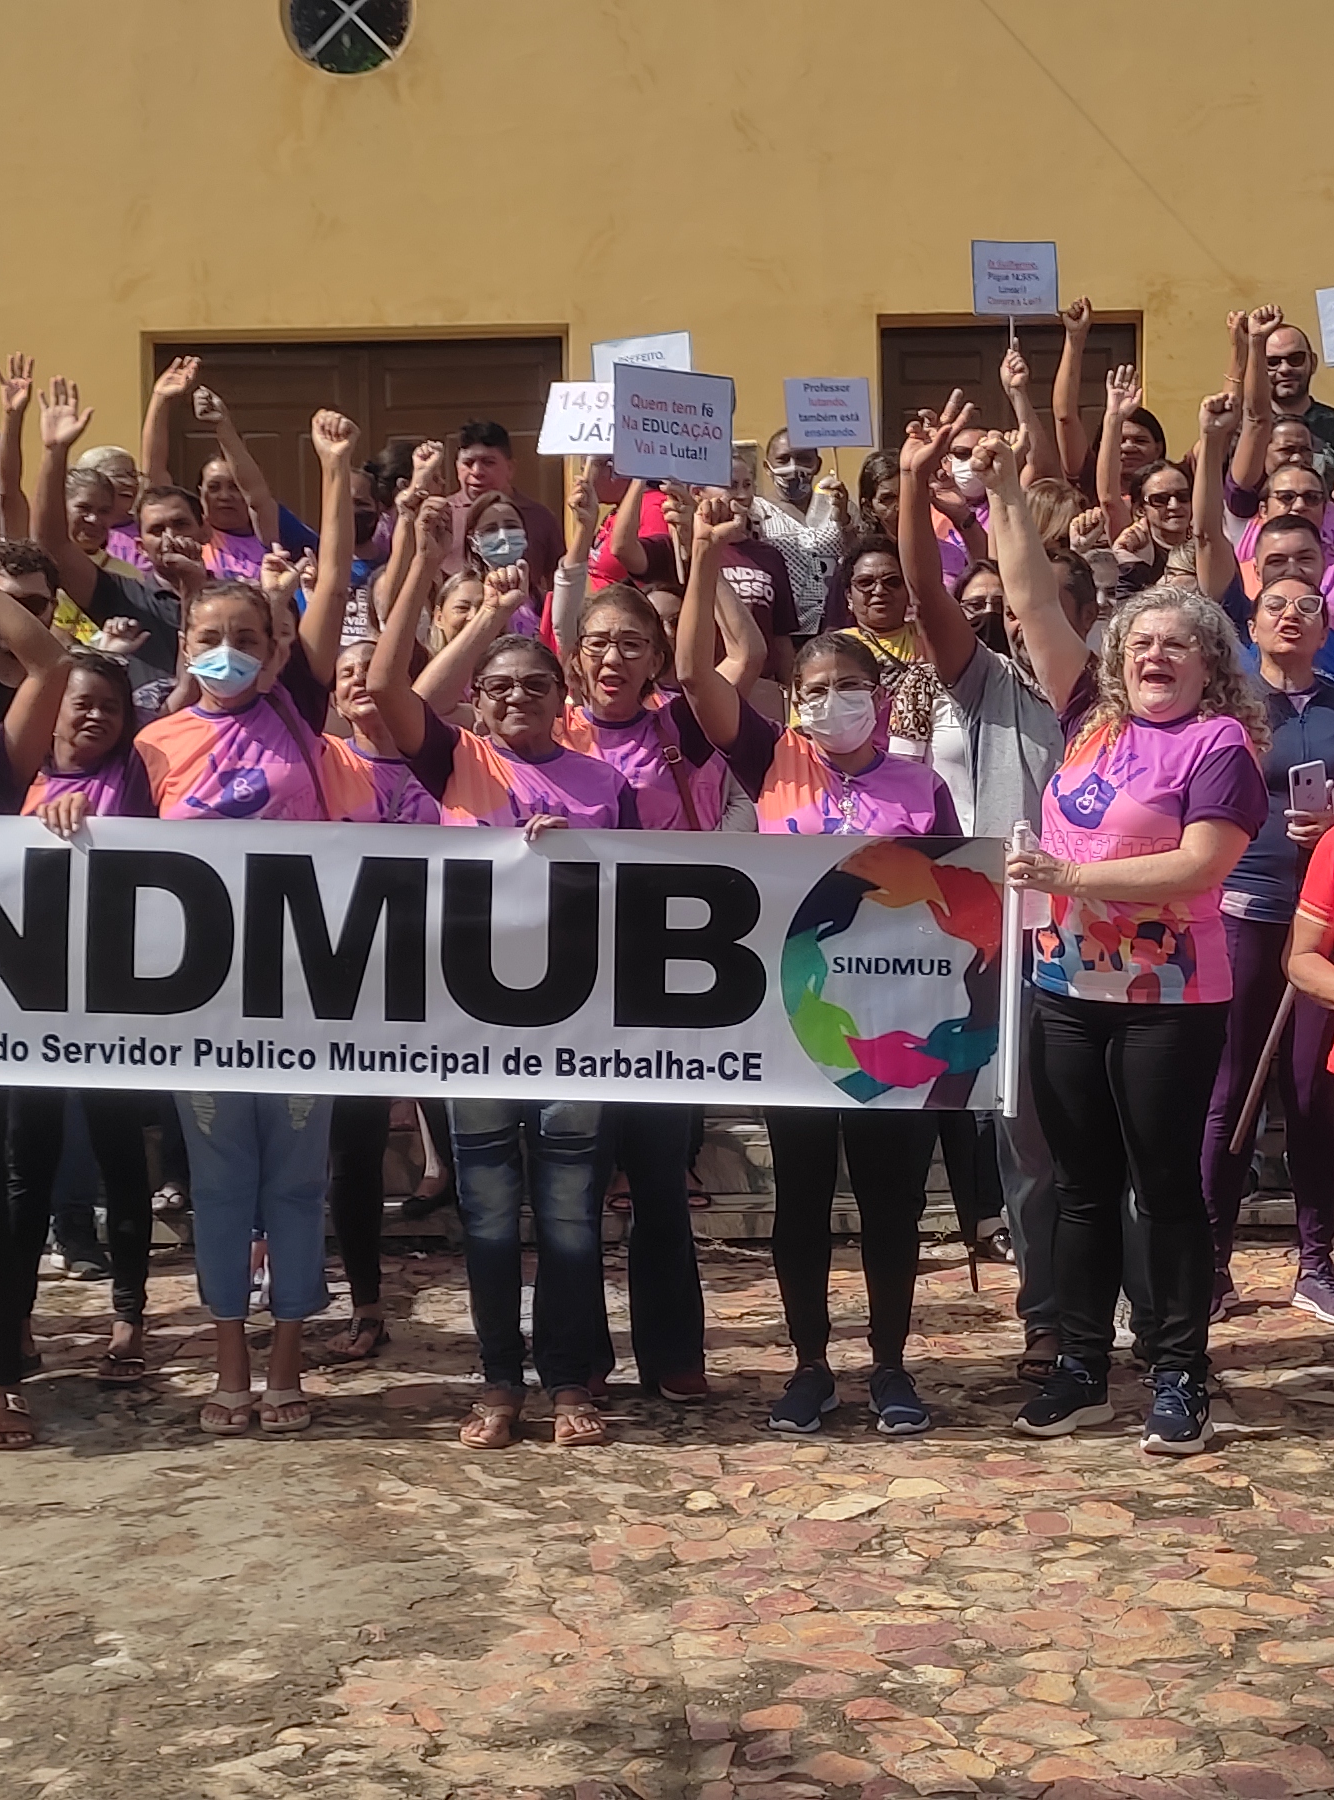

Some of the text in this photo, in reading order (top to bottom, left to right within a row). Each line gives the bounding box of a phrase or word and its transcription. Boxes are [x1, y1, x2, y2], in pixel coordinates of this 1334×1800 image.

[803, 383, 850, 392] Professor
[631, 393, 667, 411] Quem
[671, 401, 697, 415] tem
[622, 415, 723, 440] Na EDUCAÇÃO
[634, 438, 708, 460] Vai a Luta!!
[832, 956, 952, 977] SINDMUB
[41, 1033, 183, 1067] Servidor
[194, 1038, 317, 1071] Publico
[328, 1042, 490, 1081] Municipal
[502, 1046, 543, 1077] de
[555, 1046, 764, 1082] Barbalha-CE
